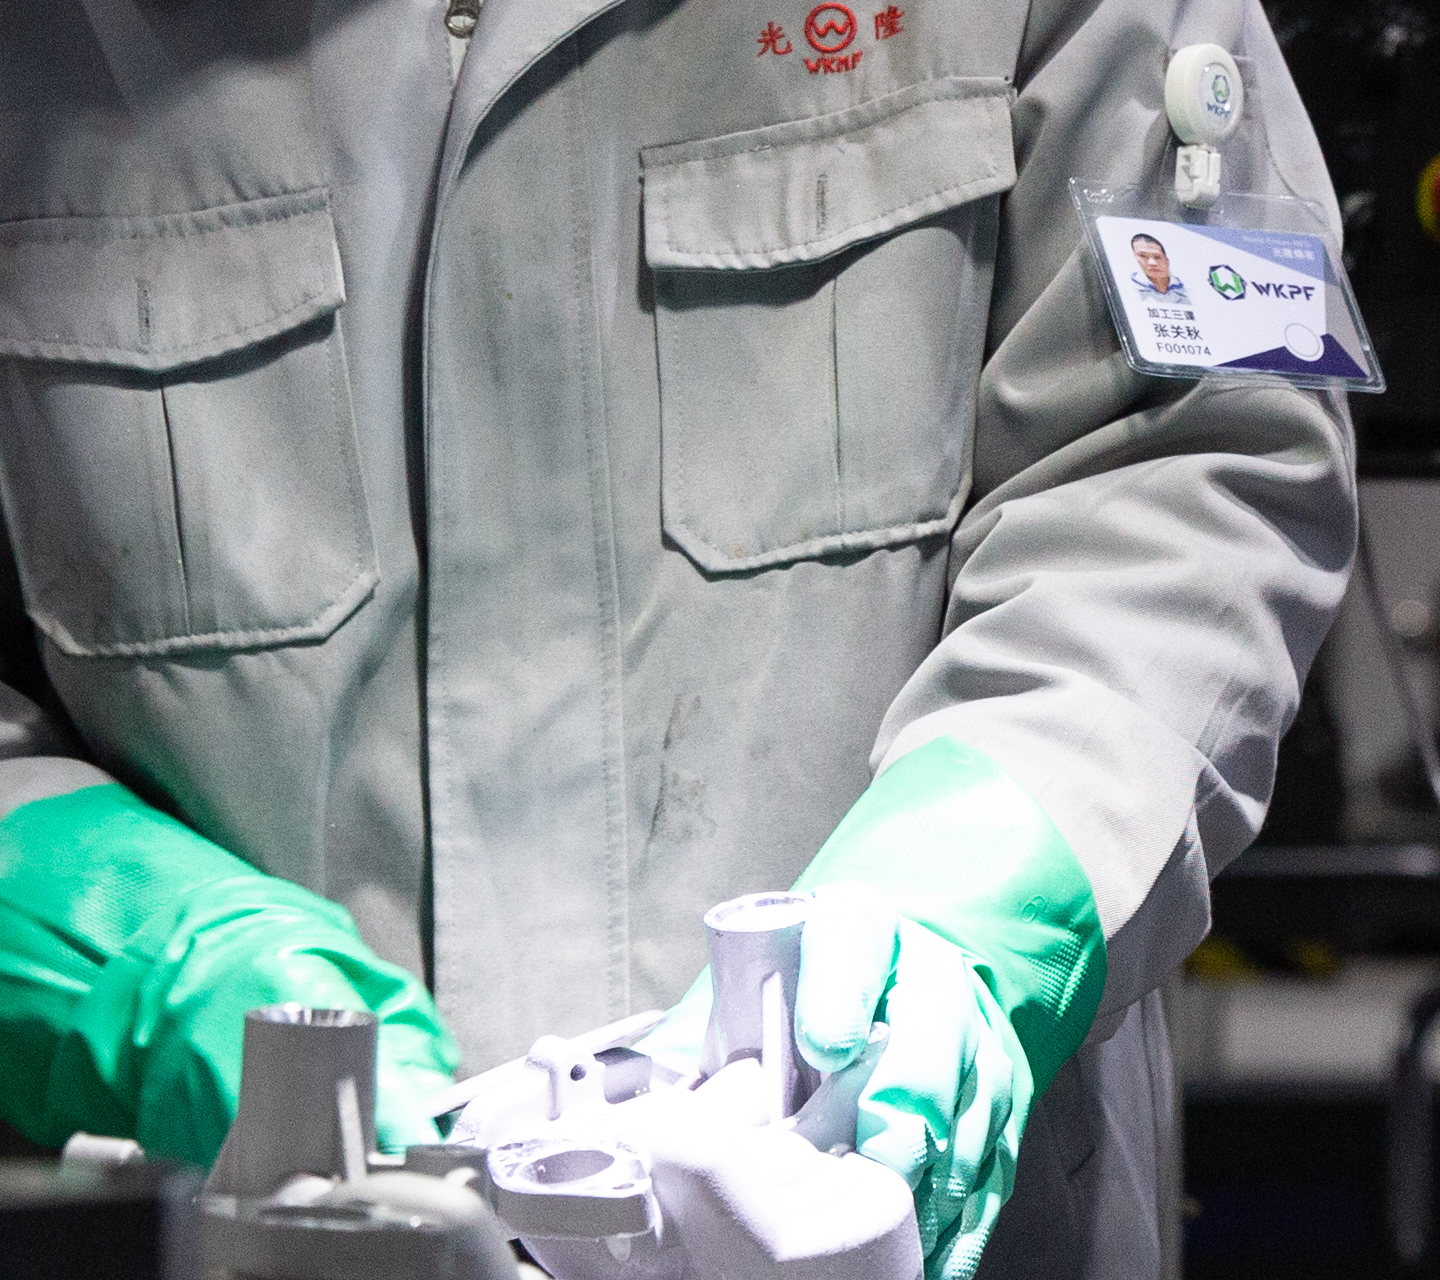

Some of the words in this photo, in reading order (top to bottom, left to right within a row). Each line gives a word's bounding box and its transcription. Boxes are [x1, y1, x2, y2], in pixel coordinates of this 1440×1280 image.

[758, 22, 793, 56] 光
[1251, 280, 1315, 301] WKPF
[1156, 341, 1211, 356] F001074
